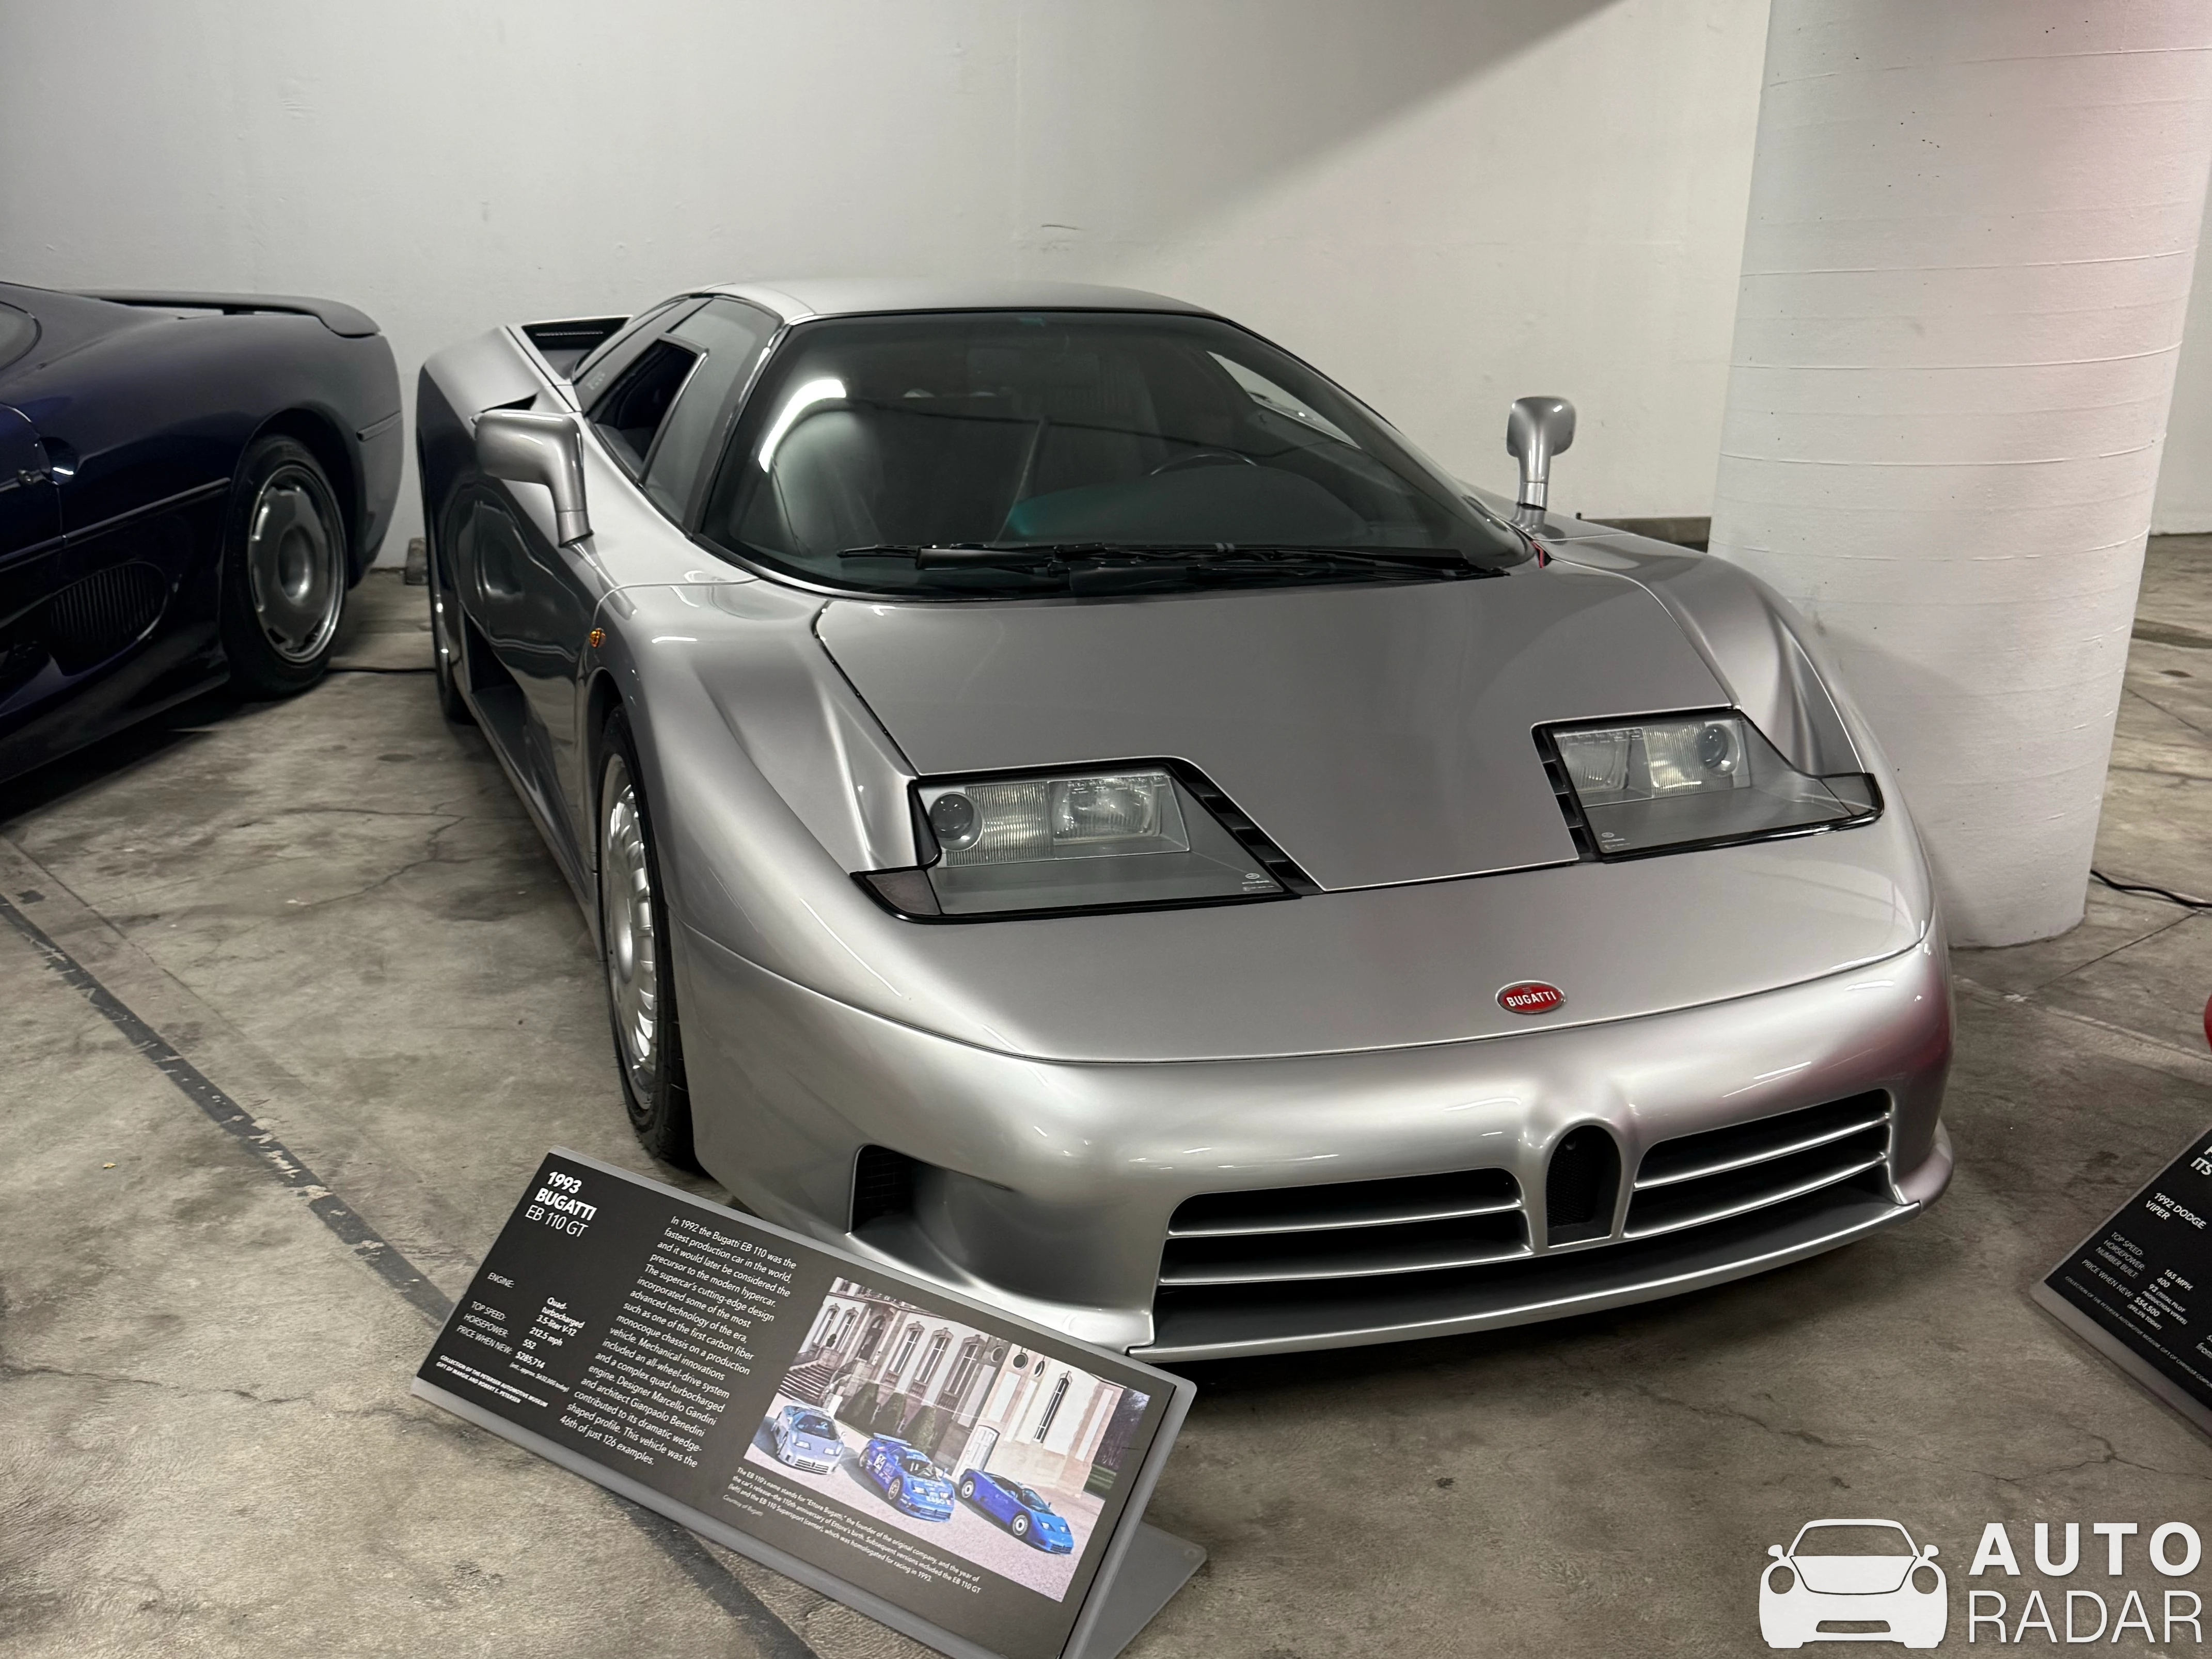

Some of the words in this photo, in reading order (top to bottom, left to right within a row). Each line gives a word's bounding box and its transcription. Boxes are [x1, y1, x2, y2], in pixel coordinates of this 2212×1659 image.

[1506, 991, 1557, 1007] BUGATTI
[2190, 1157, 2212, 1175] ITS
[547, 1171, 582, 1194] 1993
[525, 1204, 545, 1221] EB
[545, 1212, 567, 1230] 110
[566, 1220, 589, 1237] GT
[534, 1188, 597, 1221] BUGATTI
[2145, 1200, 2170, 1220] VIPER
[2154, 1193, 2175, 1209] 1992
[2172, 1205, 2207, 1229] DODGE
[664, 1227, 690, 1244] fastest
[688, 1239, 731, 1259] production
[731, 1255, 745, 1264] car
[744, 1258, 753, 1268] in
[753, 1261, 767, 1273] the
[767, 1269, 792, 1284] world,
[671, 1215, 680, 1225] In
[680, 1219, 700, 1233] 1992
[698, 1226, 712, 1237] the
[712, 1231, 741, 1247] Bugatti
[740, 1241, 753, 1252] EB
[753, 1246, 767, 1258] 110
[767, 1254, 783, 1264] was
[782, 1258, 797, 1269] the
[2104, 1239, 2145, 1271] HORSEPOWER:
[2111, 1231, 2125, 1242] TOP
[2122, 1240, 2143, 1257] SPEED:
[657, 1242, 675, 1252] and
[672, 1245, 680, 1255] it
[680, 1250, 705, 1263] would
[703, 1257, 722, 1270] later
[721, 1263, 733, 1275] be
[733, 1271, 778, 1292] considered
[776, 1286, 791, 1297] the
[2095, 1246, 2122, 1267] NUMBER
[2120, 1263, 2138, 1279] BUILT:
[487, 1272, 515, 1288] ENGINE:
[644, 1263, 659, 1276] The
[659, 1272, 698, 1291] supercar's
[697, 1287, 747, 1311] cutting-edge
[747, 1305, 775, 1322] design
[649, 1254, 688, 1272] precursor
[687, 1267, 696, 1275] to
[696, 1270, 710, 1281] the
[709, 1277, 740, 1293] modern
[740, 1286, 776, 1307] hypercar.
[2081, 1259, 2100, 1274] PRICE
[2098, 1271, 2119, 1287] WHEN
[2116, 1284, 2134, 1299] NEW:
[2157, 1277, 2170, 1288] 400
[2164, 1269, 2177, 1279] 165
[2175, 1277, 2193, 1291] MPH
[471, 1301, 486, 1311] TOP
[483, 1307, 507, 1322] SPEED:
[546, 1297, 567, 1310] Quad-
[637, 1276, 687, 1302] incorporated
[685, 1298, 707, 1310] some
[707, 1305, 719, 1314] of
[716, 1308, 730, 1320] the
[730, 1315, 752, 1328] most
[2134, 1297, 2160, 1317] $54,500
[2142, 1290, 2171, 1313] PRODUCTION
[2148, 1284, 2158, 1292] 93
[2171, 1301, 2186, 1313] PILOT
[463, 1313, 509, 1338] HORSEPOWER:
[535, 1314, 563, 1331] 3.5-liter
[560, 1324, 577, 1337] V-12
[541, 1306, 586, 1329] turbocharged
[623, 1303, 642, 1314] such
[641, 1310, 652, 1318] as
[651, 1314, 667, 1325] one
[667, 1320, 679, 1329] of
[676, 1322, 690, 1334] the
[690, 1327, 707, 1341] first
[706, 1337, 734, 1352] carbon
[734, 1346, 755, 1361] fiber
[629, 1290, 669, 1309] advanced
[667, 1304, 710, 1329] technology
[709, 1321, 721, 1330] of
[719, 1324, 733, 1336] the
[733, 1332, 747, 1344] era,
[456, 1325, 477, 1338] PRICE
[475, 1333, 496, 1347] WHEN
[494, 1341, 513, 1354] NEW:
[522, 1338, 537, 1350] 552
[529, 1326, 549, 1340] 212.5
[547, 1336, 563, 1347] mph
[616, 1315, 661, 1338] monocoque
[661, 1333, 689, 1349] chassis
[689, 1345, 700, 1354] on
[705, 1353, 750, 1376] production
[440, 1355, 466, 1370] COLLECTION
[515, 1351, 546, 1369] $285,714
[602, 1338, 637, 1358] included
[635, 1354, 646, 1363] an
[645, 1357, 702, 1387] all-wheel-drive
[701, 1382, 730, 1399] system
[610, 1328, 637, 1344] vehicle.
[638, 1337, 683, 1362] Mechanical
[681, 1355, 725, 1381] innovations
[588, 1366, 615, 1382] engine.
[616, 1376, 652, 1397] Designer
[651, 1391, 685, 1412] Marcello
[685, 1406, 718, 1426] Gandini
[595, 1353, 613, 1364] and
[617, 1362, 650, 1381] complex
[649, 1376, 726, 1413] quad-turbocharged
[574, 1391, 620, 1415] contributed
[618, 1409, 627, 1419] to
[626, 1413, 638, 1424] its
[638, 1418, 673, 1440] dramatic
[672, 1435, 703, 1452] wedge-
[580, 1378, 599, 1389] and
[596, 1385, 631, 1404] architect
[630, 1398, 670, 1421] Gianpaolo
[669, 1415, 706, 1437] Benedini
[559, 1415, 578, 1429] 46th
[577, 1424, 590, 1433] of
[584, 1427, 603, 1441] just
[603, 1434, 618, 1447] 126
[616, 1443, 654, 1465] examples.
[566, 1402, 597, 1420] shaped
[593, 1417, 621, 1433] profile.
[623, 1426, 640, 1441] This
[639, 1436, 667, 1454] vehicle
[667, 1449, 684, 1461] was
[683, 1455, 698, 1468] the
[737, 1466, 747, 1476] The
[754, 1475, 767, 1485] 110's
[855, 1521, 877, 1535] founder
[882, 1534, 892, 1542] the
[891, 1539, 914, 1552] original
[912, 1549, 937, 1565] company,
[918, 1562, 943, 1576] included
[942, 1572, 952, 1581] the
[952, 1576, 961, 1585] EB
[961, 1581, 972, 1590] 110
[971, 1585, 982, 1593] GT
